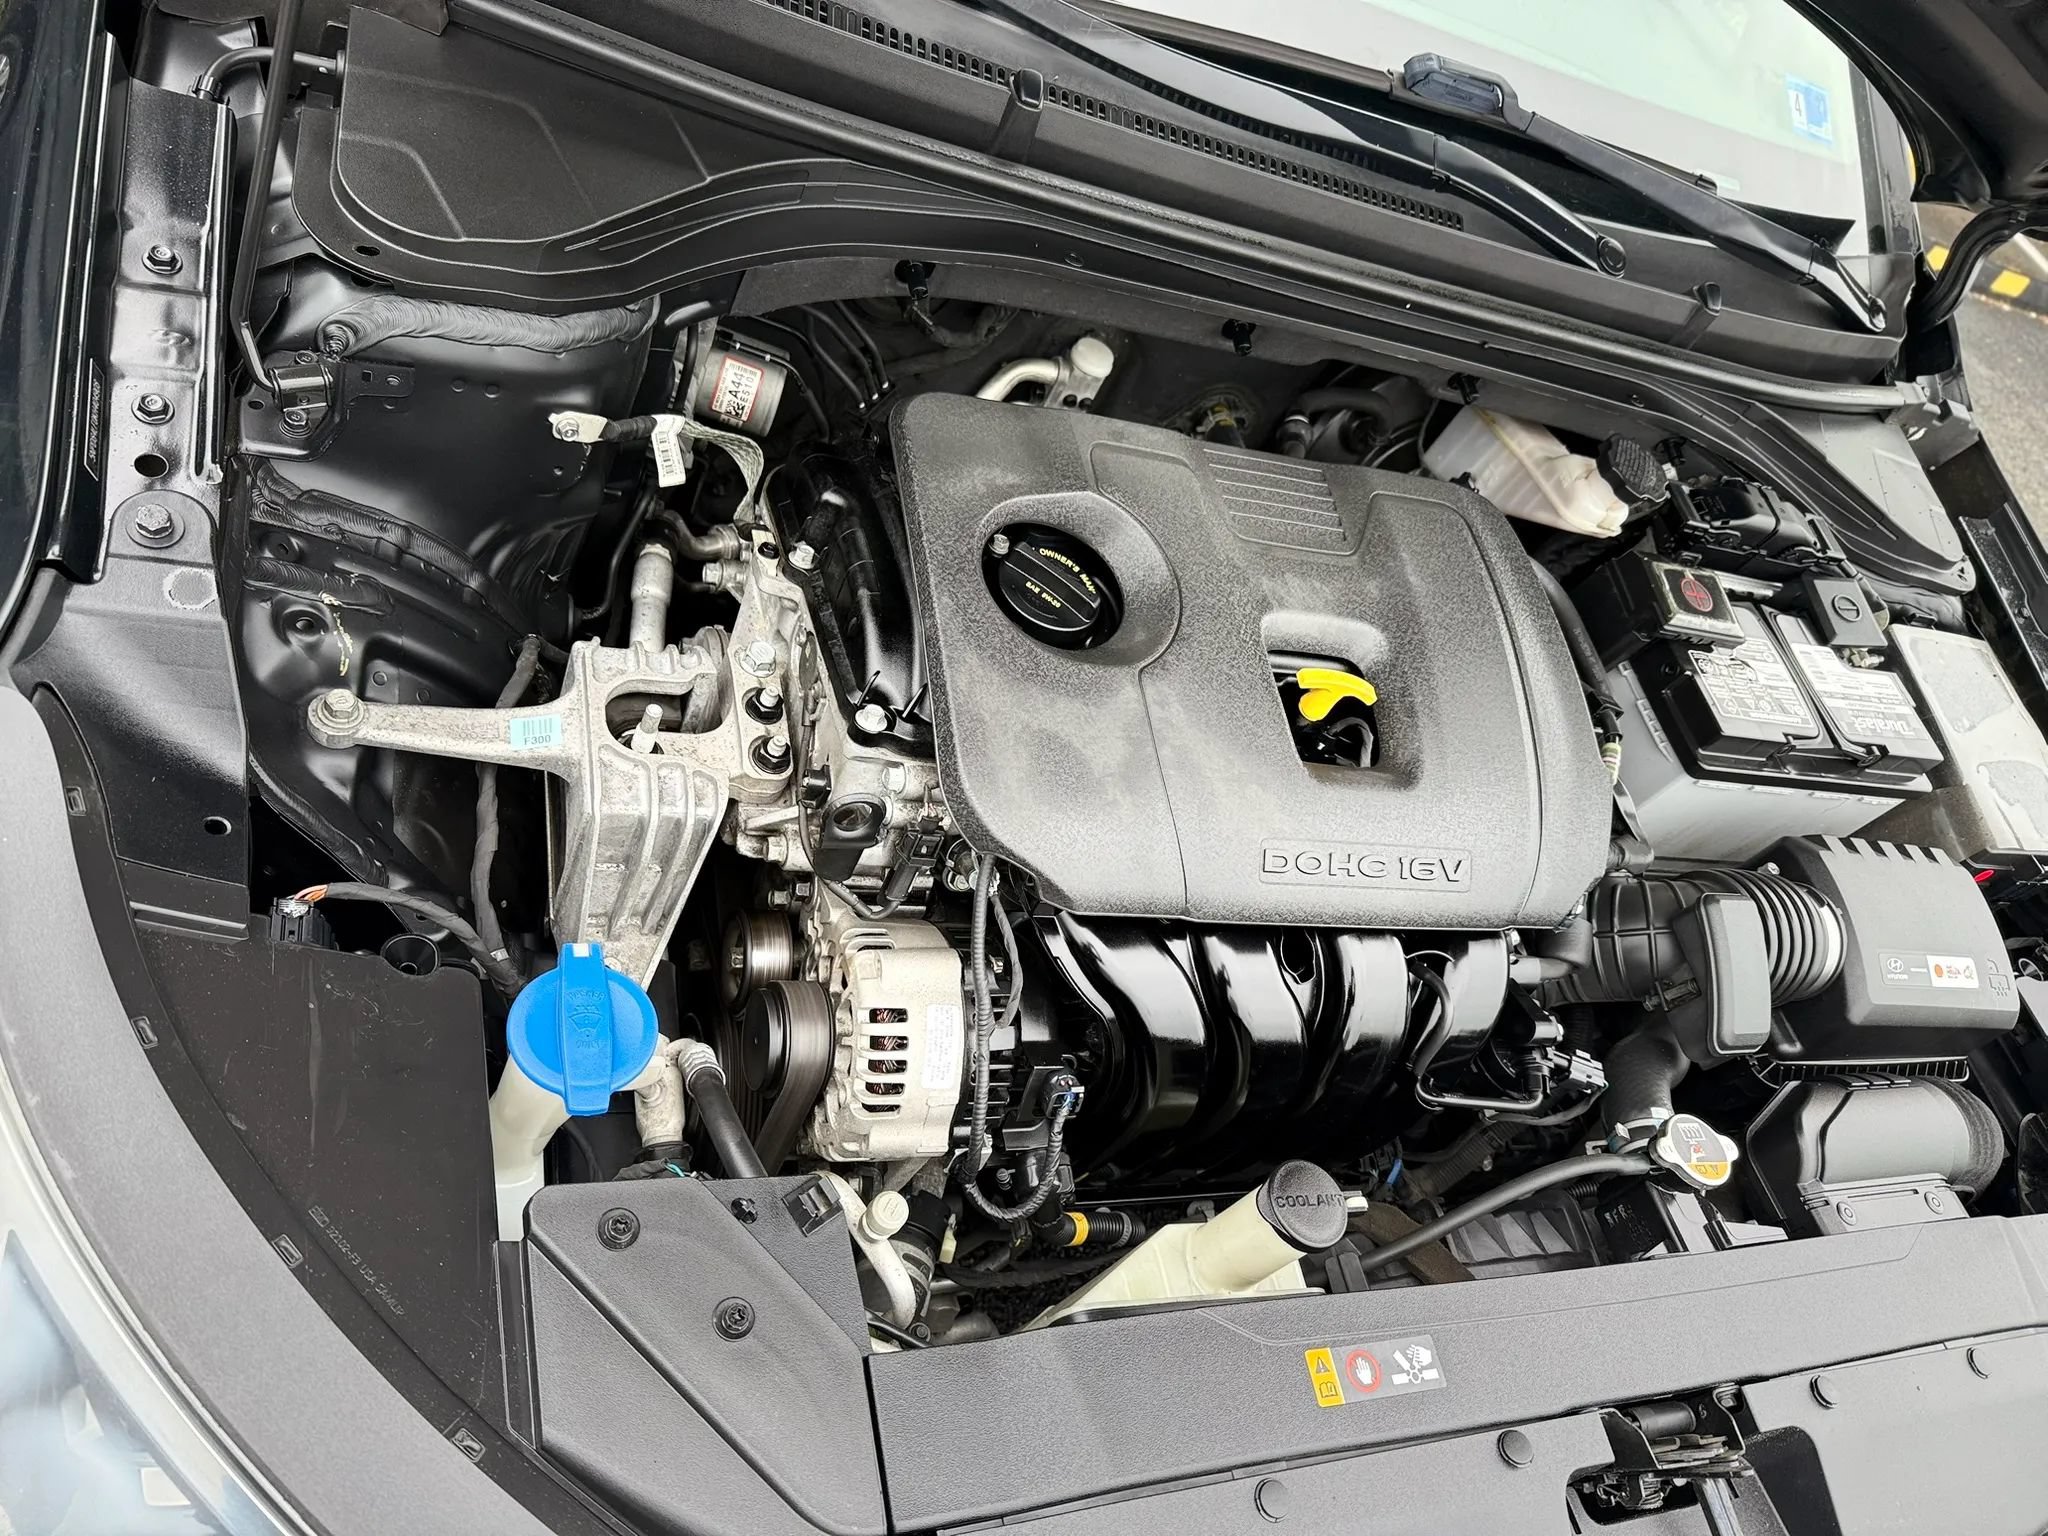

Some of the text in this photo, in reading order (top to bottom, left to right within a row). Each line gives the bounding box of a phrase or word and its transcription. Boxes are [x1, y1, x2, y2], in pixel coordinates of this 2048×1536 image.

[728, 372, 745, 400] A44
[1039, 548, 1081, 573] OWNER'S
[1851, 716, 1915, 735] Duralast
[524, 734, 552, 746] F300
[1262, 848, 1463, 883] DOHC 16V
[1274, 1194, 1344, 1209] COOLANT
